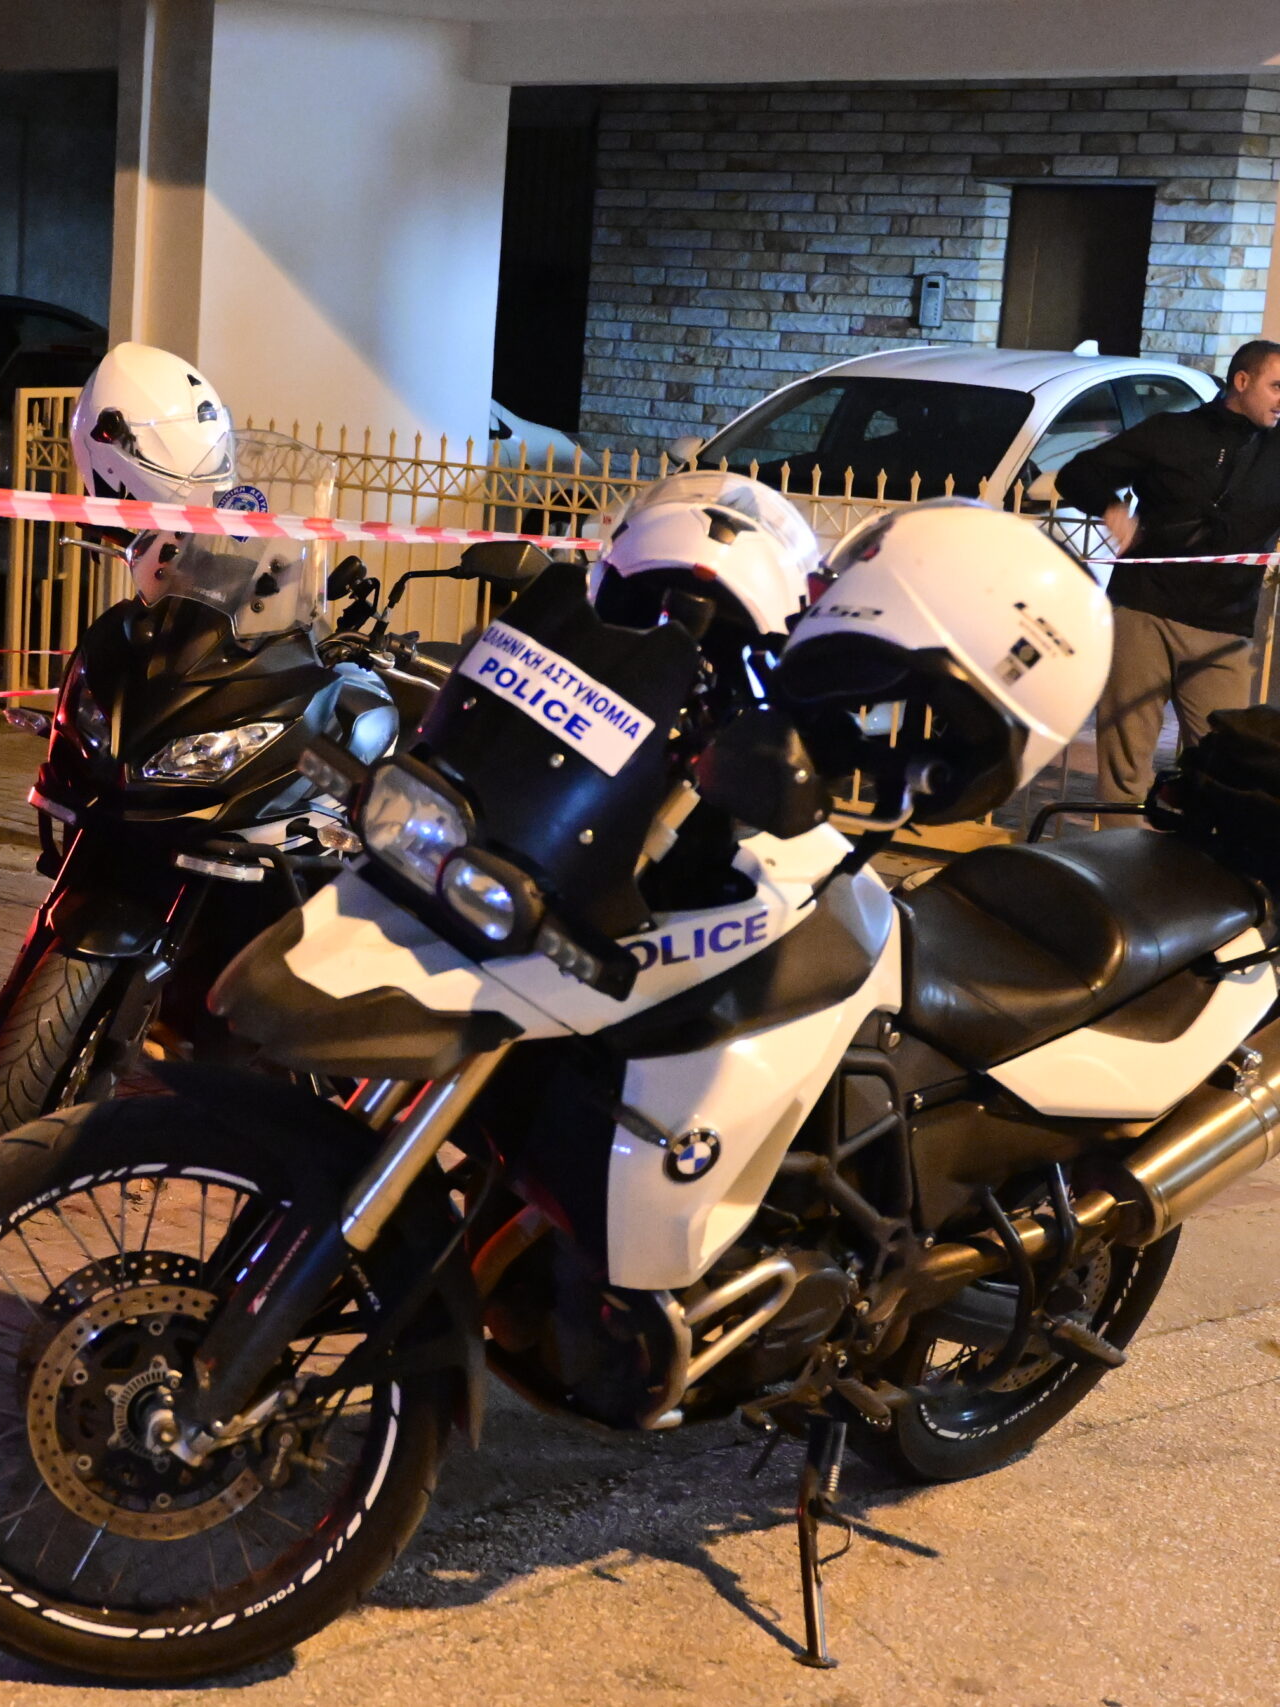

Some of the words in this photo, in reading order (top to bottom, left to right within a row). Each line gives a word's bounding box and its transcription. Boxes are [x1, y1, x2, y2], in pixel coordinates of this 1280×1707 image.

[478, 657, 592, 740] POLICE
[542, 662, 641, 740] ΑΣΤΥΝΟΜΙΑ
[622, 911, 768, 971] OLICE
[9, 1187, 60, 1223] POLICE
[1003, 1402, 1036, 1425] POLICE
[243, 1582, 296, 1617] POLICE
